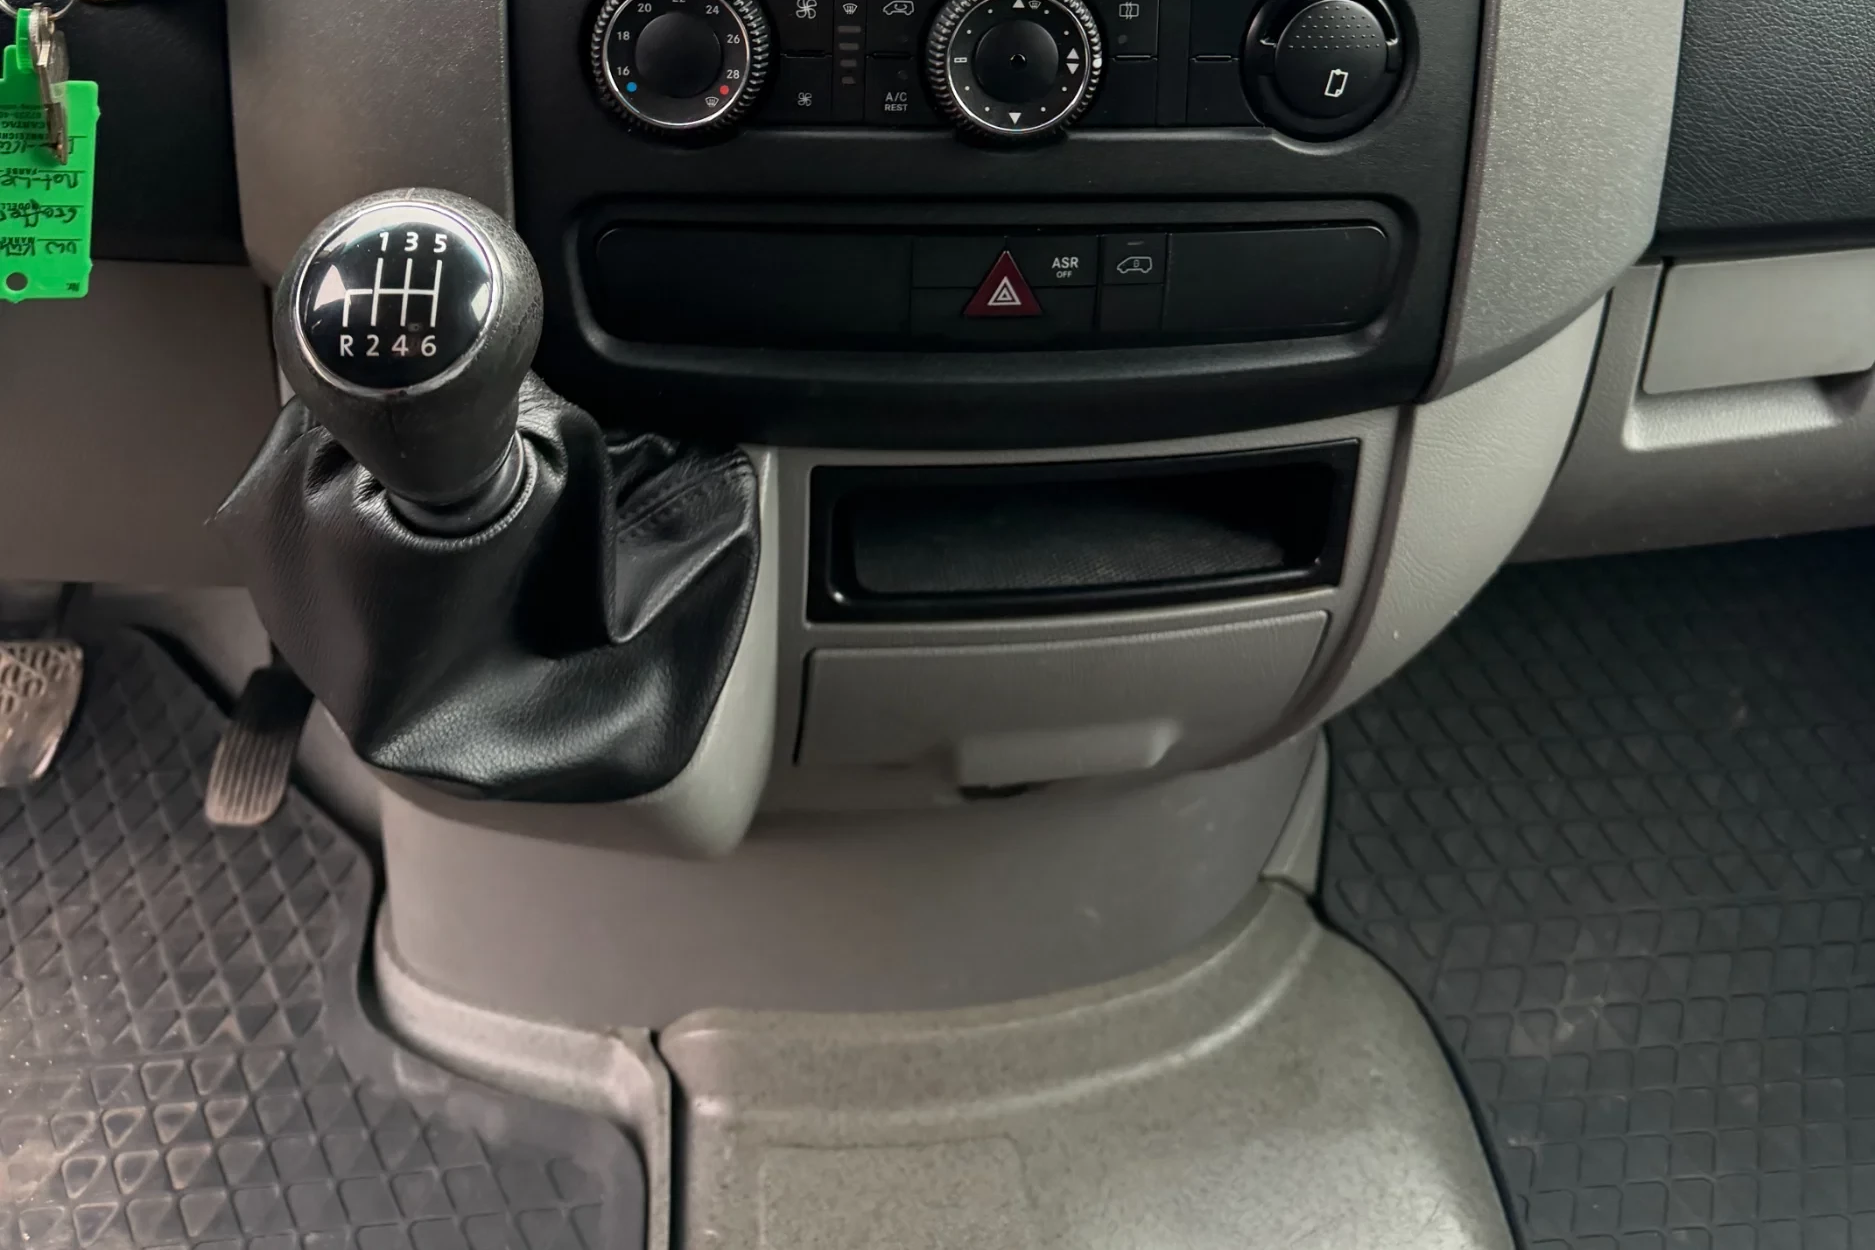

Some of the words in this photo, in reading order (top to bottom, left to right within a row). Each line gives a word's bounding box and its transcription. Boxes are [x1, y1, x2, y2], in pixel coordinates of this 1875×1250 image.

[637, 3, 652, 13] 20
[706, 5, 720, 15] 24
[617, 31, 630, 41] 18
[727, 34, 741, 44] 26
[617, 66, 630, 76] 16
[726, 69, 740, 80] 28
[885, 91, 908, 102] A/C
[884, 103, 908, 112] REST
[379, 231, 389, 252] 1
[404, 231, 419, 252] 3
[433, 233, 448, 253] 5
[1051, 256, 1079, 269] ASR
[1056, 270, 1073, 279] OFF
[340, 334, 354, 357] R
[366, 334, 380, 357] 2
[391, 334, 409, 357] 4
[420, 334, 437, 357] 6
